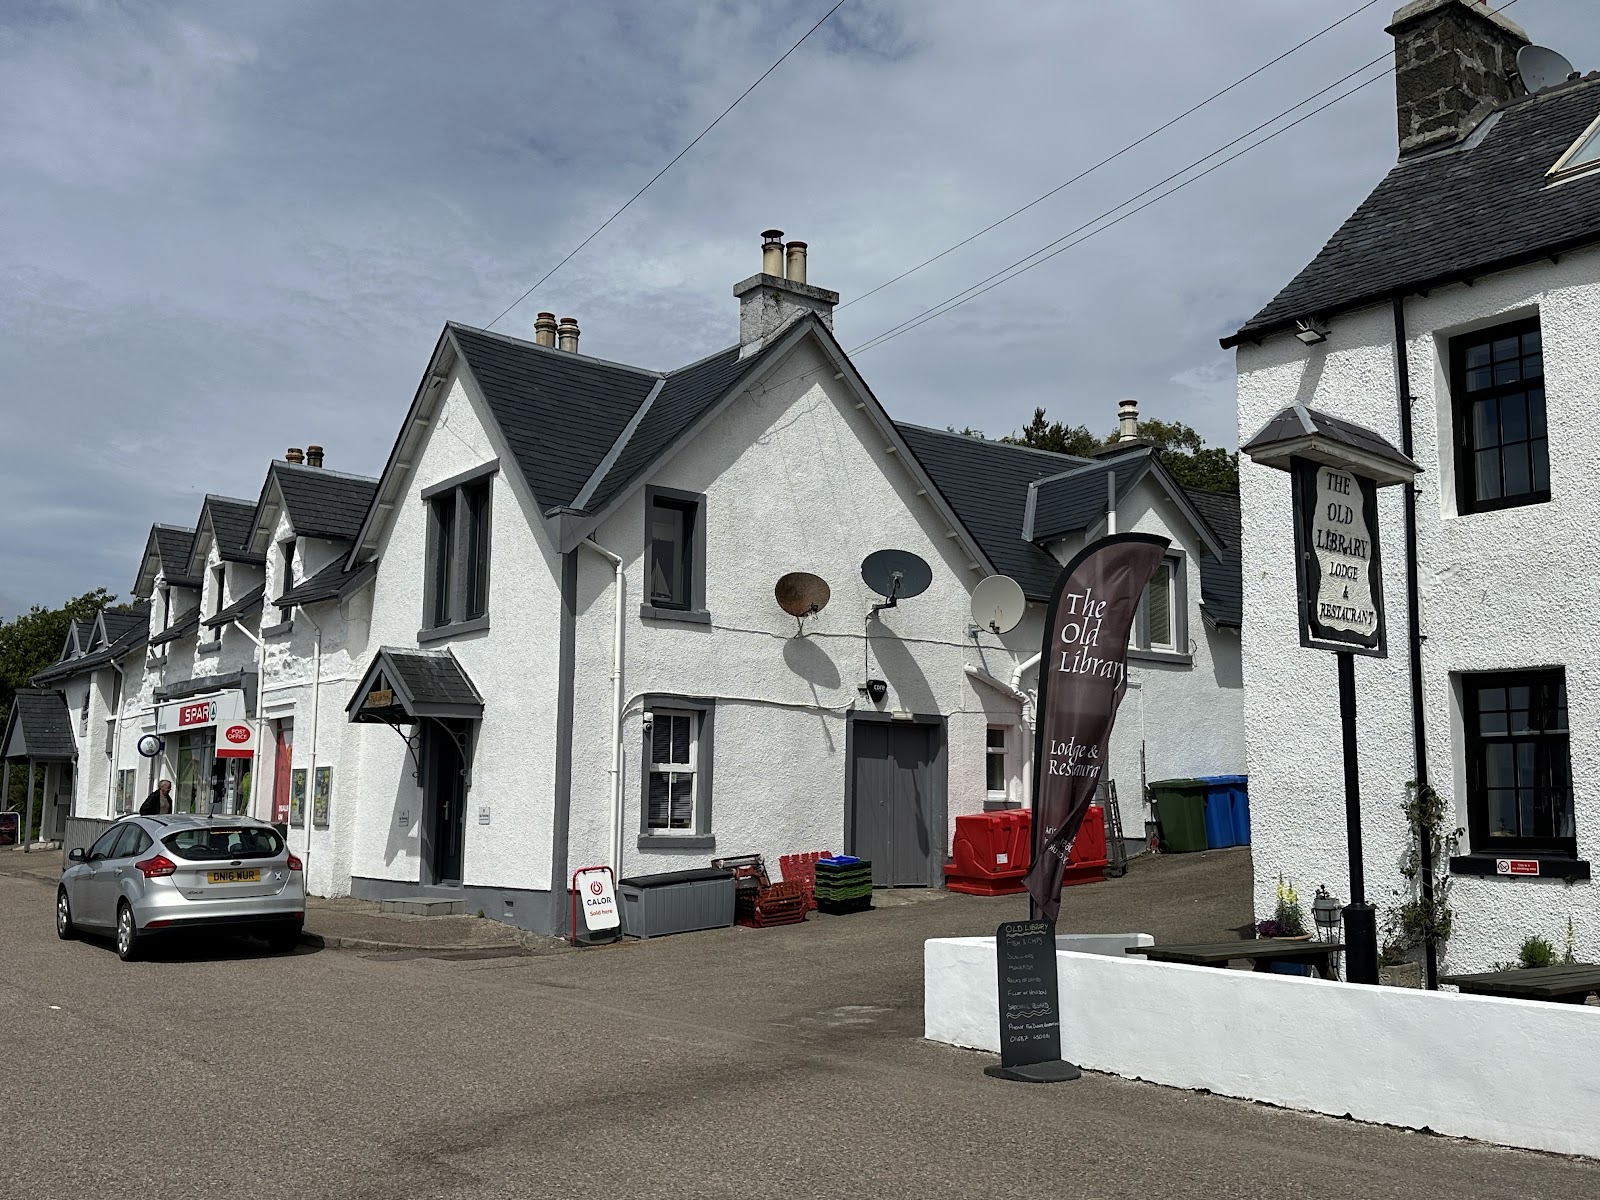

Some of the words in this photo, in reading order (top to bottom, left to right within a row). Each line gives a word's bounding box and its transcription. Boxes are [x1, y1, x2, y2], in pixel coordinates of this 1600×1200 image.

[1326, 472, 1351, 496] THE
[1327, 502, 1353, 525] OLD
[1316, 528, 1369, 559] LIBRARY
[1329, 561, 1358, 580] LODGE
[1067, 588, 1106, 618] The
[1342, 585, 1349, 600] &
[1319, 602, 1374, 625] RESTAURANT
[1061, 617, 1102, 646] Old
[184, 705, 209, 723] SPAR
[1050, 737, 1086, 764] Lodge
[1087, 744, 1099, 759] &
[1048, 759, 1101, 778] Restaura
[213, 871, 234, 881] DN16
[236, 870, 255, 880] WUR
[586, 897, 612, 906] CALOR
[1005, 924, 1023, 933] OLD
